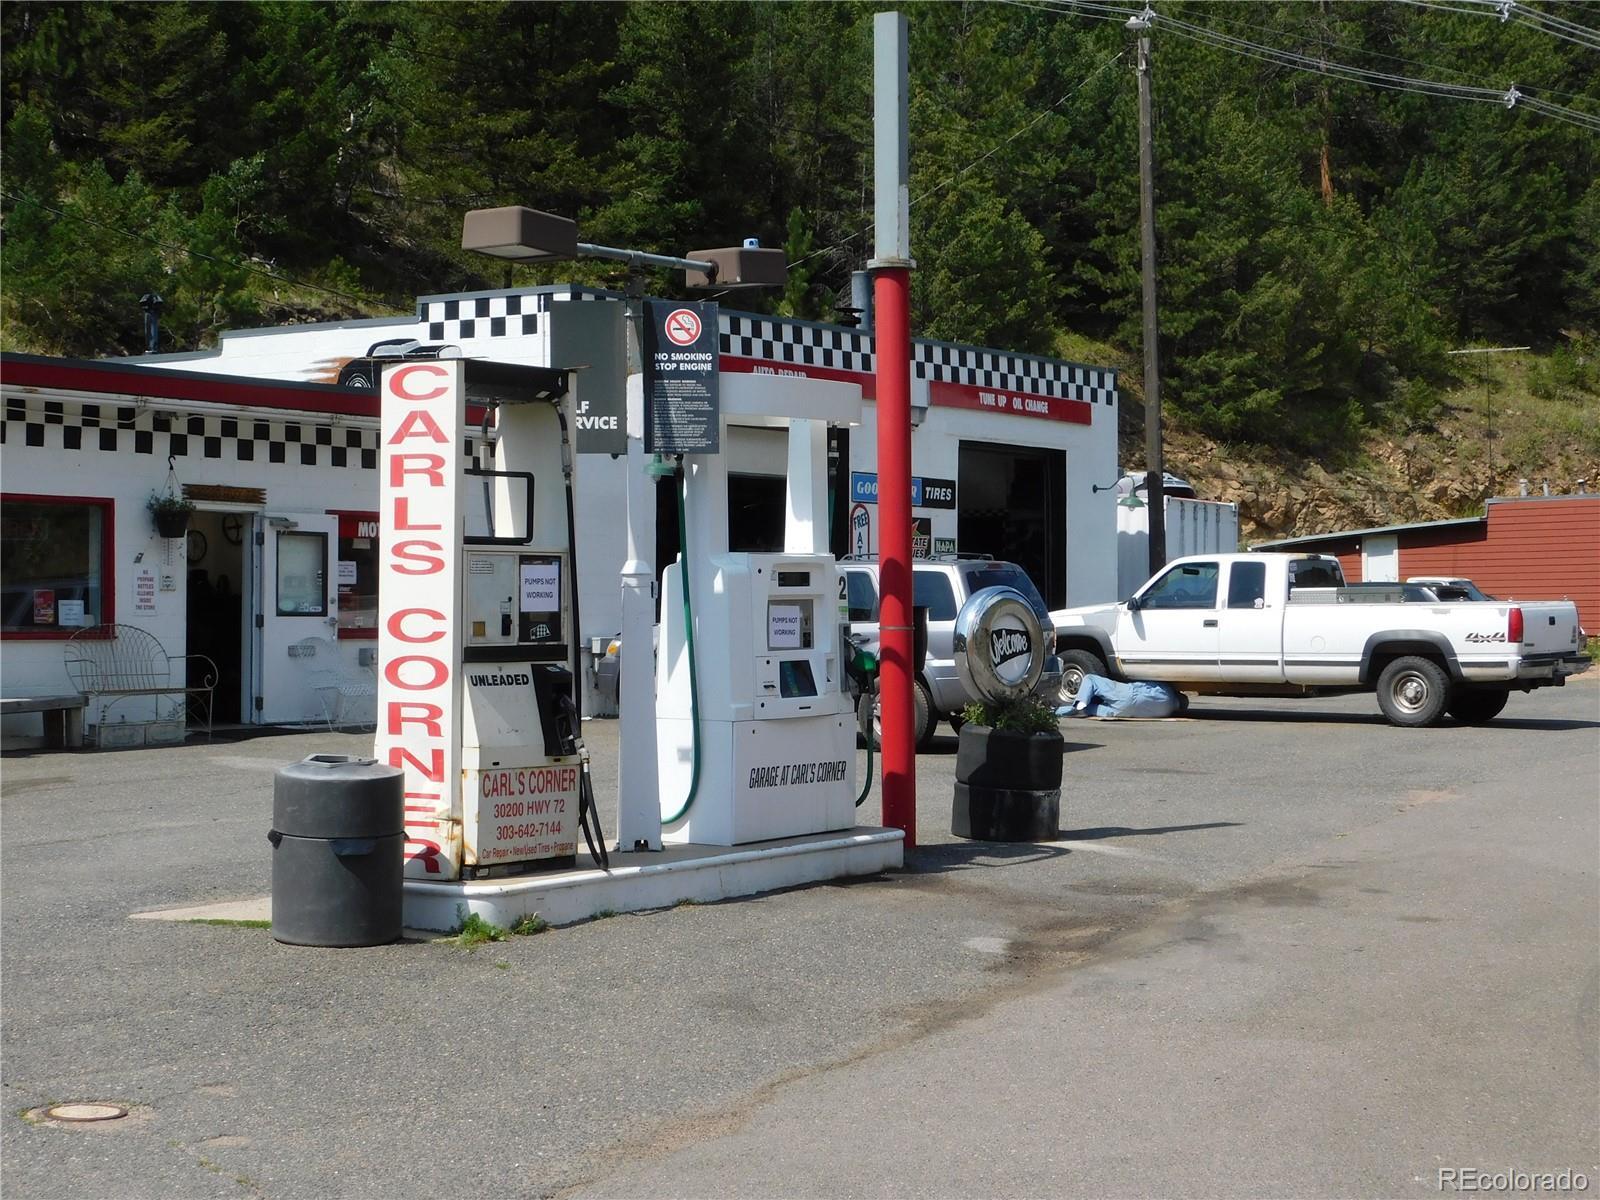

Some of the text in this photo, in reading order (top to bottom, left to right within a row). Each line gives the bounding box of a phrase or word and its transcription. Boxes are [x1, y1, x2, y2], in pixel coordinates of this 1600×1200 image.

[654, 352, 713, 361] NO SMOKING
[655, 362, 713, 371] STOP ENGINE
[978, 391, 1049, 414] TUNE UP OIL CHANGE
[387, 364, 450, 576] CARLS
[925, 486, 953, 501] TIRES
[853, 511, 869, 531] FREE
[935, 540, 955, 553] NAPA
[524, 577, 556, 585] PUMPS NOT
[838, 575, 847, 600] 2
[526, 591, 554, 599] WORKING
[772, 616, 798, 624] PUMPS NOT
[773, 628, 796, 636] WORKING
[1464, 632, 1506, 643] 4x4
[992, 629, 1028, 665] Welcome
[470, 673, 530, 687] UNLEADED
[384, 607, 449, 874] CORNER
[749, 760, 847, 789] GARAGE AT CARL'S CORNER
[482, 768, 577, 798] CARL'S CORNER
[493, 798, 565, 819] 30200 HWY 72
[496, 821, 562, 841] 303-642-7144
[492, 847, 509, 859] Repair
